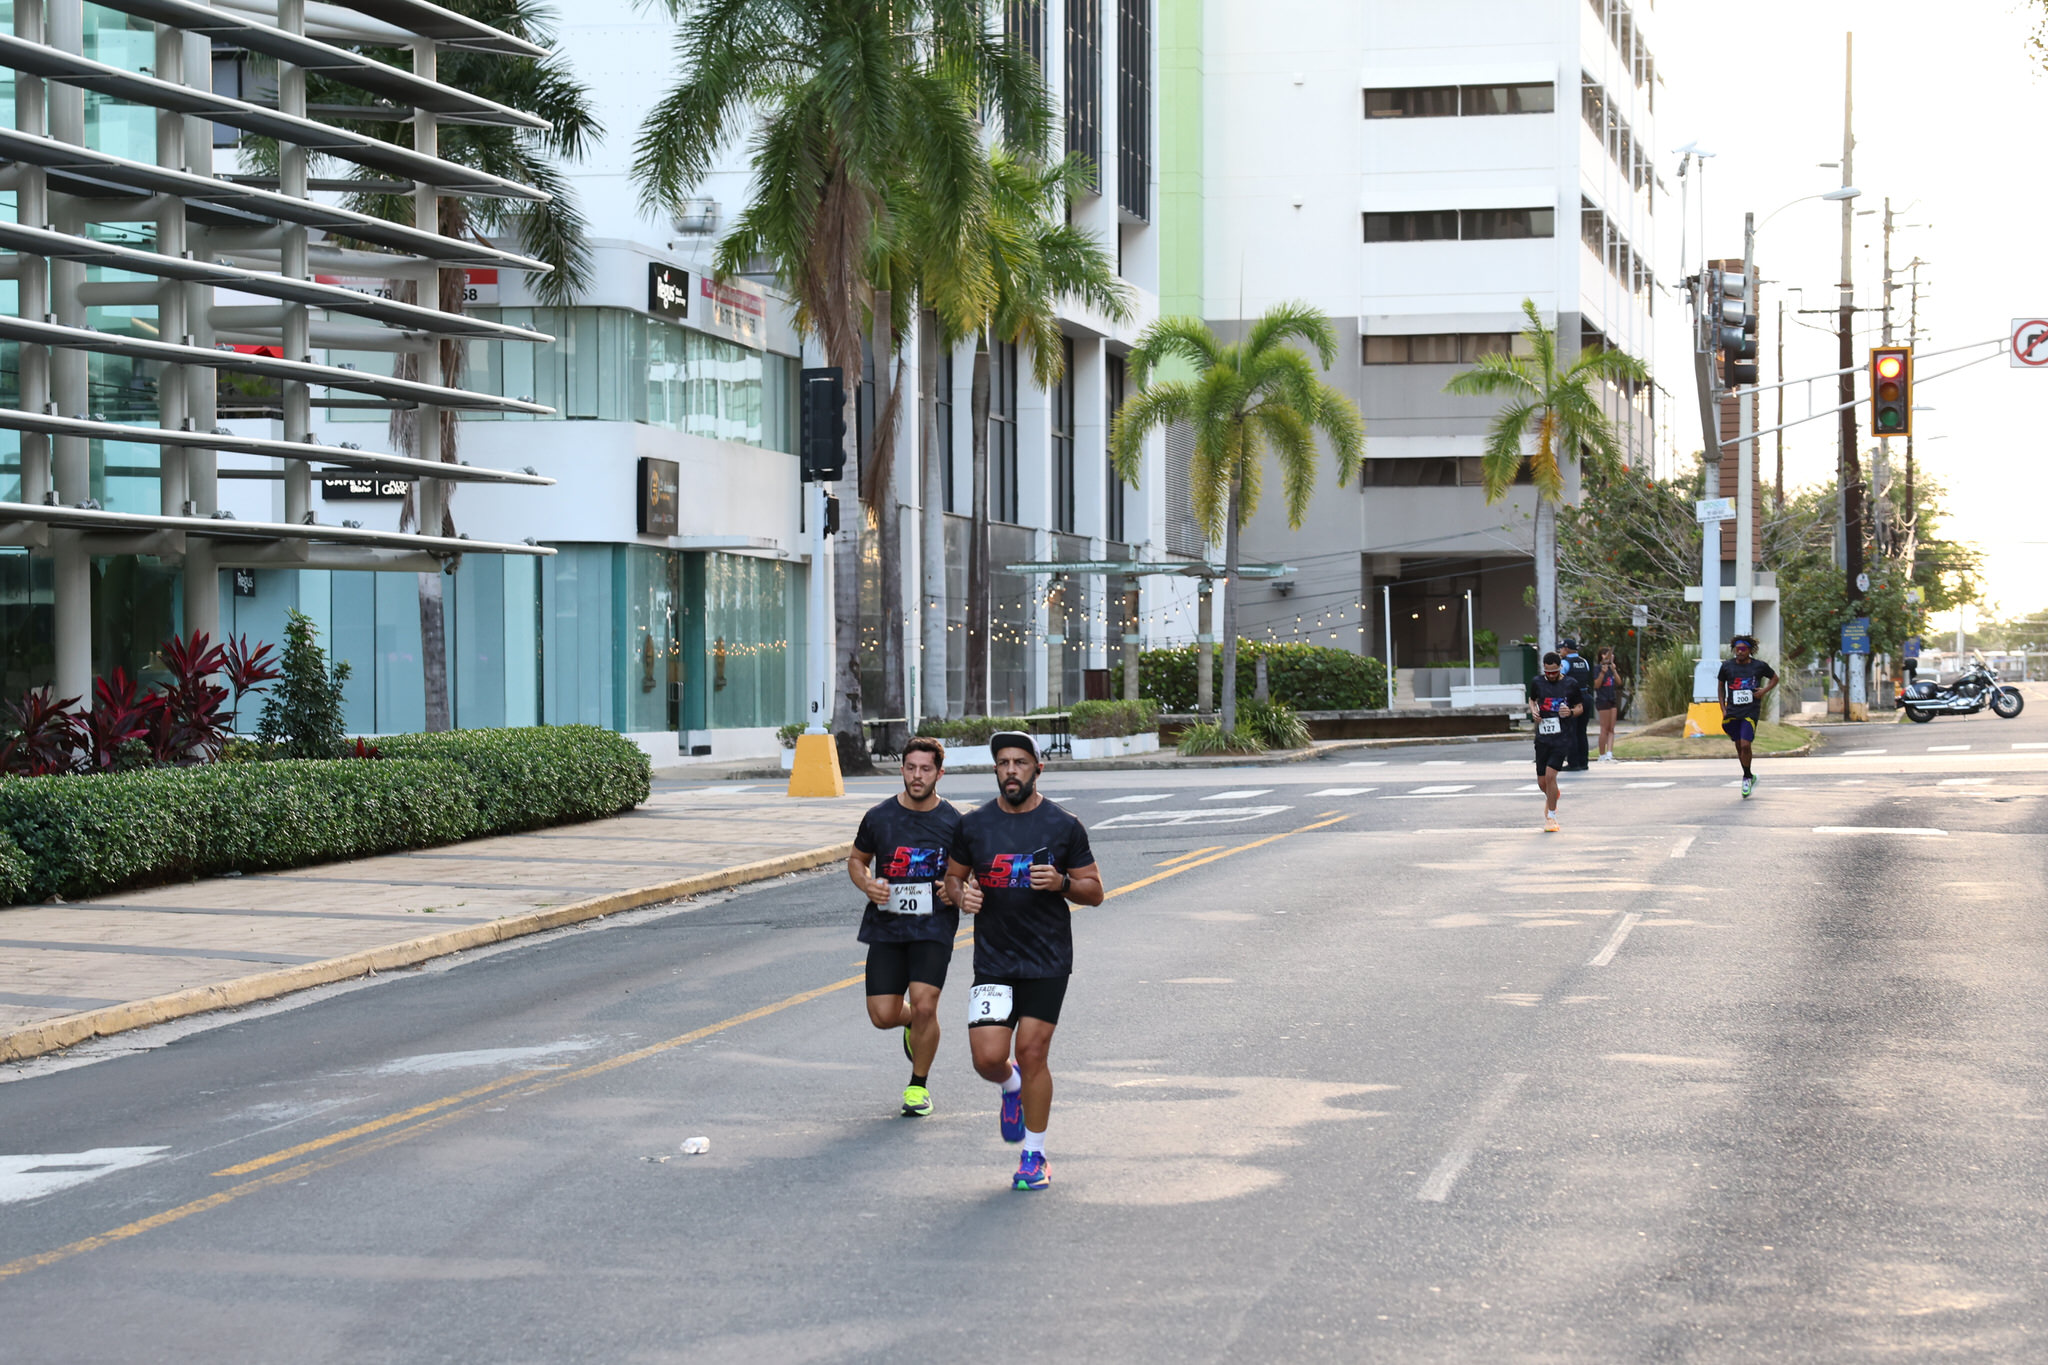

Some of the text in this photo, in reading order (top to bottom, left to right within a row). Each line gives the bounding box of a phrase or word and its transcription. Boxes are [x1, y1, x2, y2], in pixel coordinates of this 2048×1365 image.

[657, 276, 675, 309] Regus
[237, 571, 254, 594] Regus
[889, 846, 936, 868] 5K
[988, 854, 1034, 878] 5K
[900, 899, 917, 911] 20
[981, 1001, 991, 1015] 3
